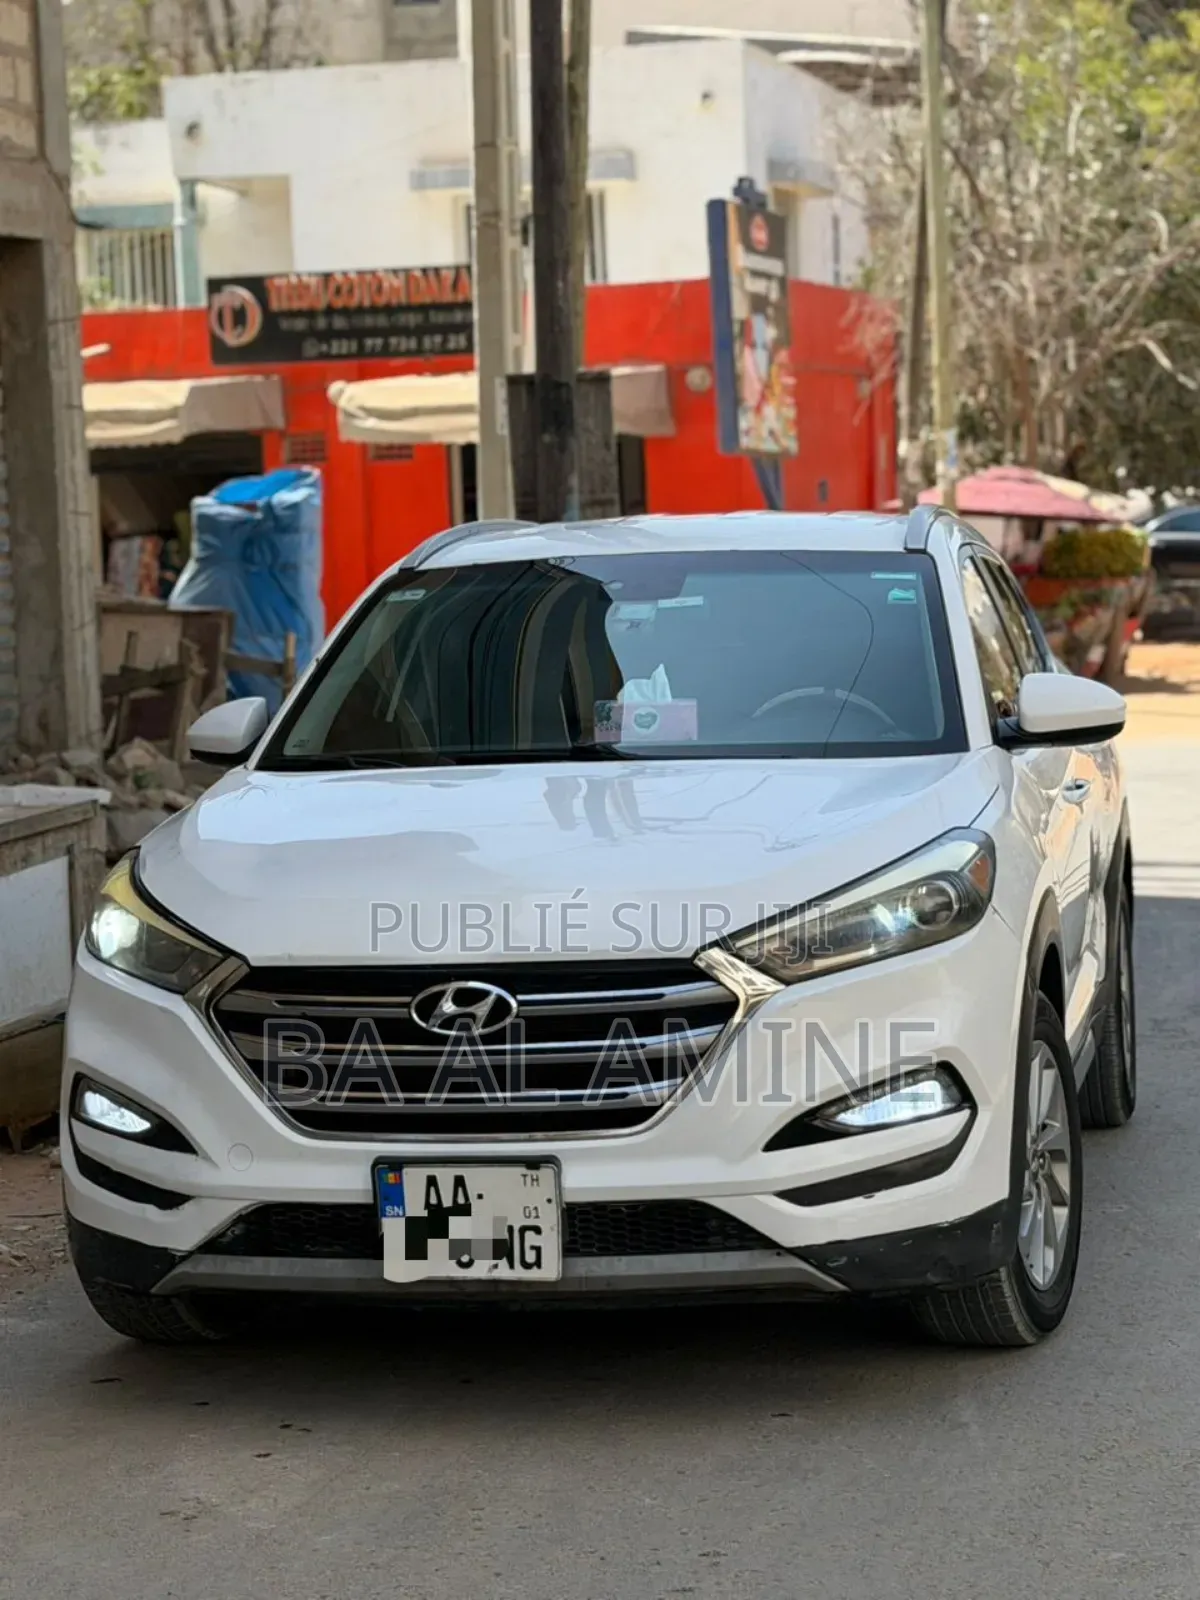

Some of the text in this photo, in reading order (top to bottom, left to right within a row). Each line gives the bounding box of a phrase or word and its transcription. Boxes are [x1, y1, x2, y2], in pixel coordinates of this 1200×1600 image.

[327, 270, 404, 309] COTON
[407, 266, 472, 305] DAKA
[520, 1173, 541, 1188] TH
[384, 1205, 404, 1217] SN
[523, 1205, 541, 1219] 01
